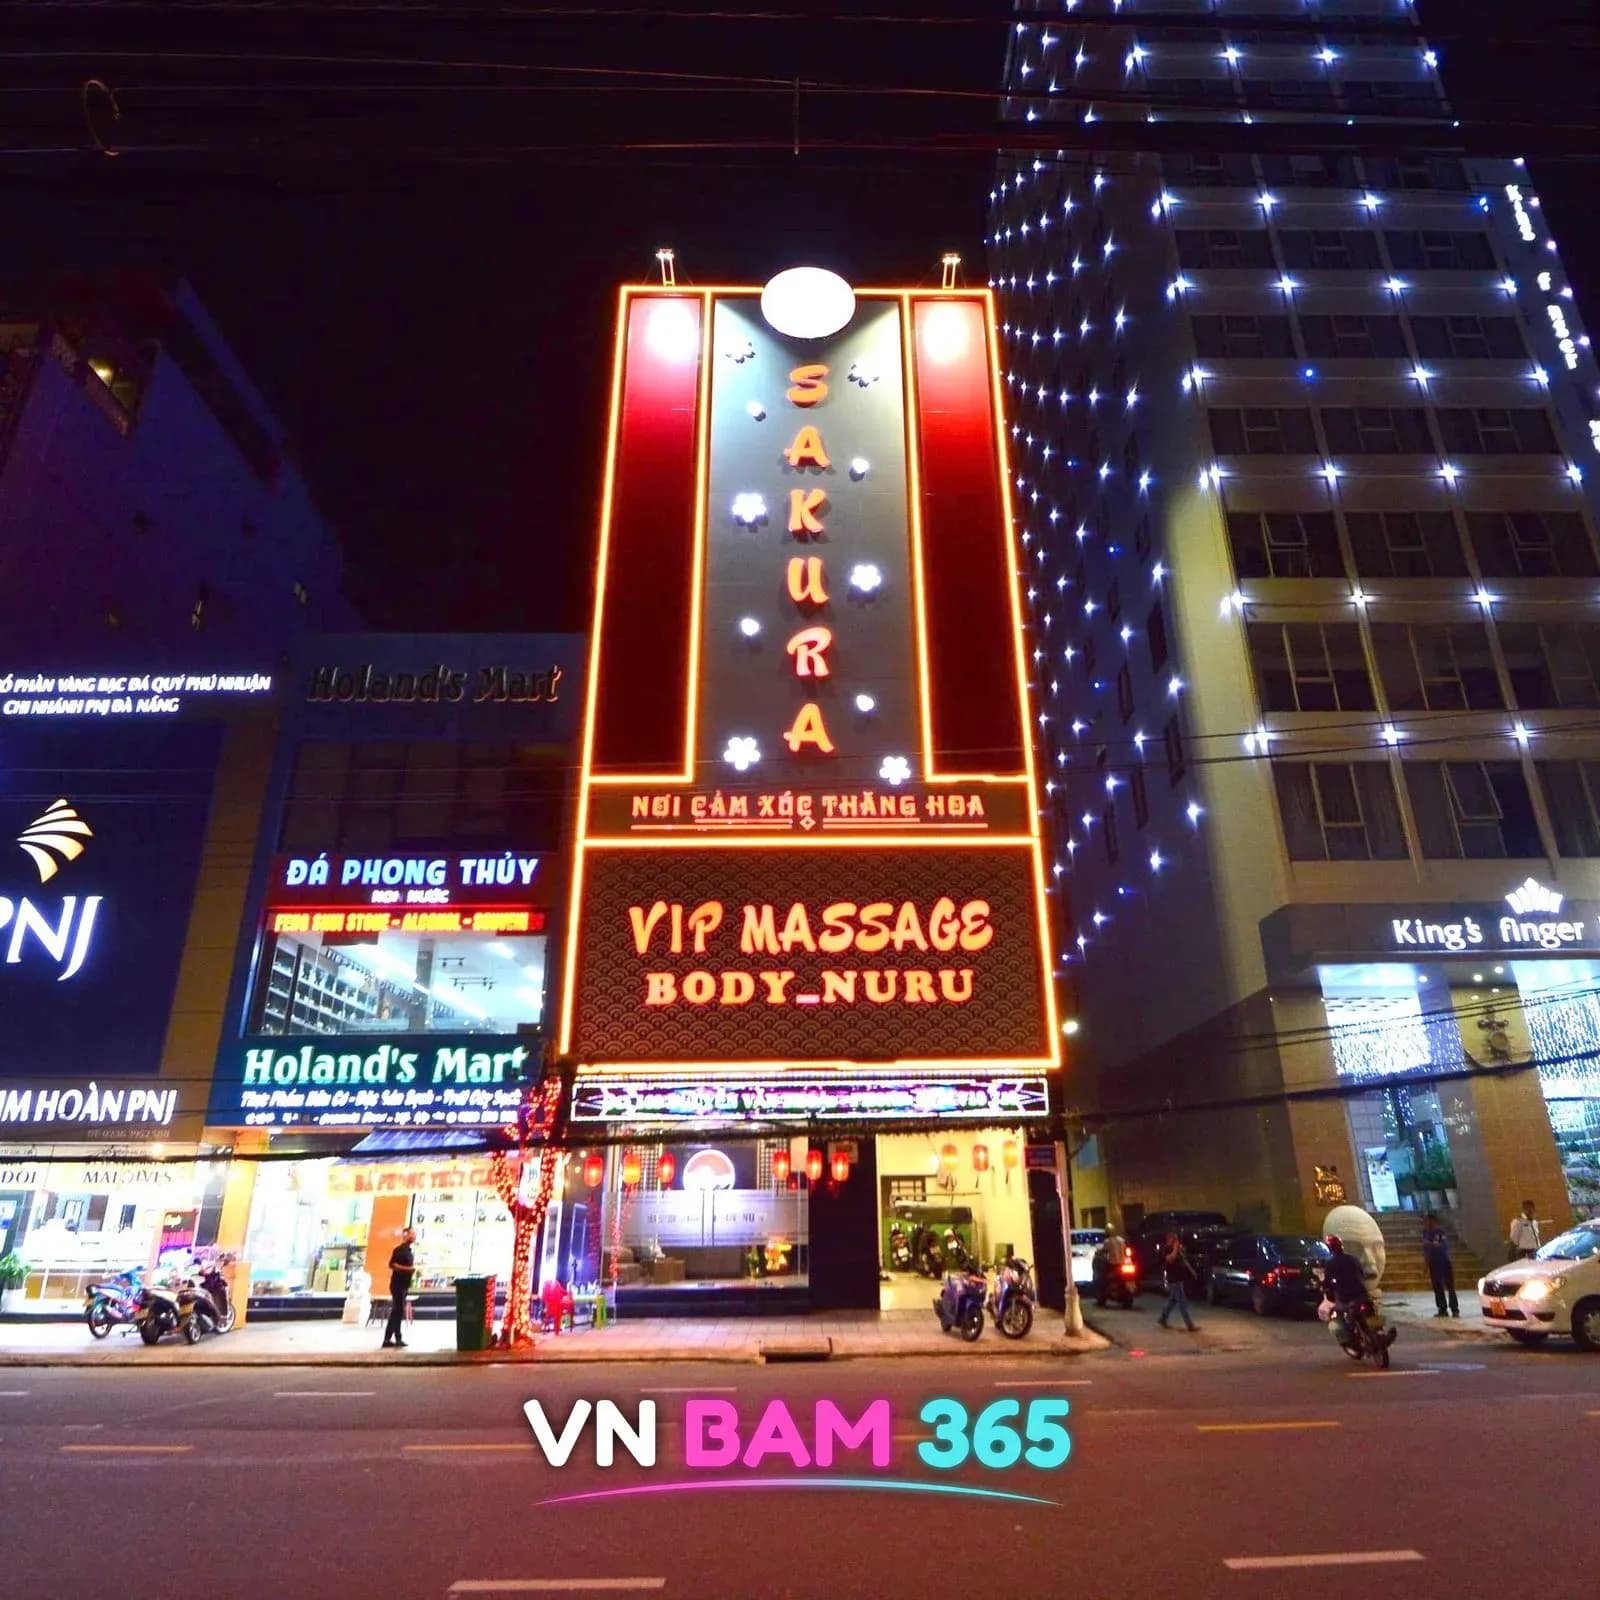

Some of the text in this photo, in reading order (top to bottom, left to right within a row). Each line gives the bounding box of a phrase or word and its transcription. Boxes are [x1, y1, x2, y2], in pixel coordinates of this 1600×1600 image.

[784, 364, 834, 753] SAKURA
[58, 675, 96, 693] VÀNG
[97, 677, 127, 694] BẠC
[128, 674, 150, 692] ĐÁ
[151, 673, 185, 693] QUÝ
[185, 673, 217, 691] PHÚ
[217, 673, 271, 693] NHUẬN
[307, 664, 562, 702] Holand's Mart
[3, 700, 31, 715] CHI
[31, 697, 85, 715] NHÁNH
[84, 700, 110, 716] PNJ
[111, 696, 132, 713] ĐÀ
[631, 790, 985, 818] NƠI CẢM XÚC THĂNG HOA
[286, 852, 538, 885] ĐÁ PHONG THỦY
[629, 898, 994, 955] VIP MASSAGE
[1392, 917, 1584, 950] King's finger
[243, 1044, 528, 1084] Holand's Mart
[33, 1081, 124, 1121] HOÀN
[125, 1089, 177, 1125] PNJ
